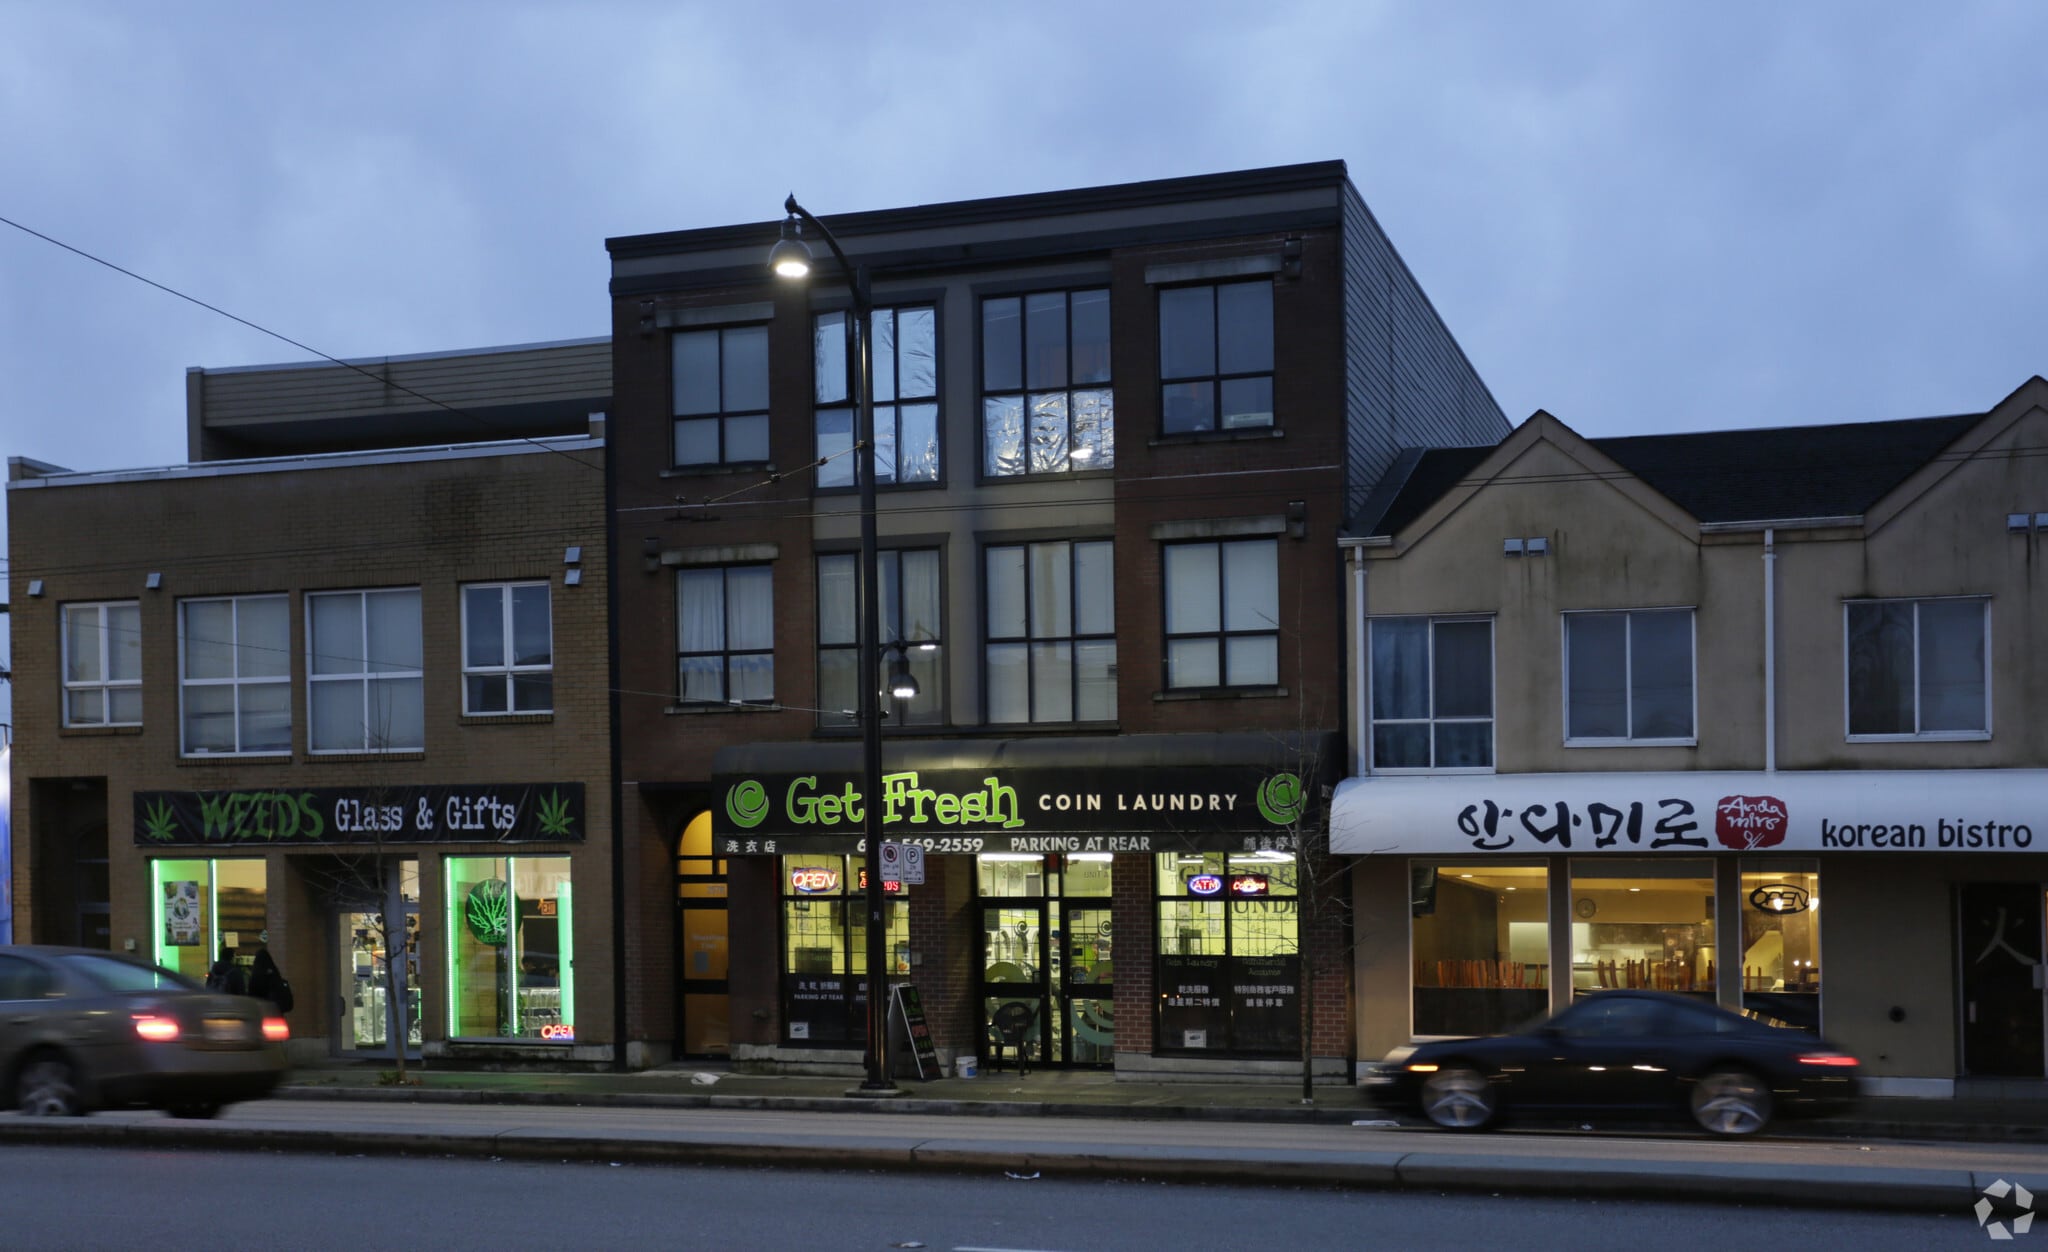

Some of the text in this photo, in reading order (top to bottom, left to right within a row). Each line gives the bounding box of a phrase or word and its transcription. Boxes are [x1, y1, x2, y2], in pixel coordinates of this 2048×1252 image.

[786, 771, 1025, 828] Get Fresh
[1039, 794, 1238, 811] COIN LAUNDRY
[199, 792, 516, 838] WEEDS Glass & Gifts
[1458, 798, 1708, 850] 안다미로
[1821, 817, 2032, 848] korean bistro
[1011, 836, 1150, 851] PARKING AT REAR
[792, 873, 837, 887] OPEN
[1193, 880, 1218, 890] ATM
[1233, 880, 1266, 891] Coee
[1753, 890, 1809, 908] OPEN
